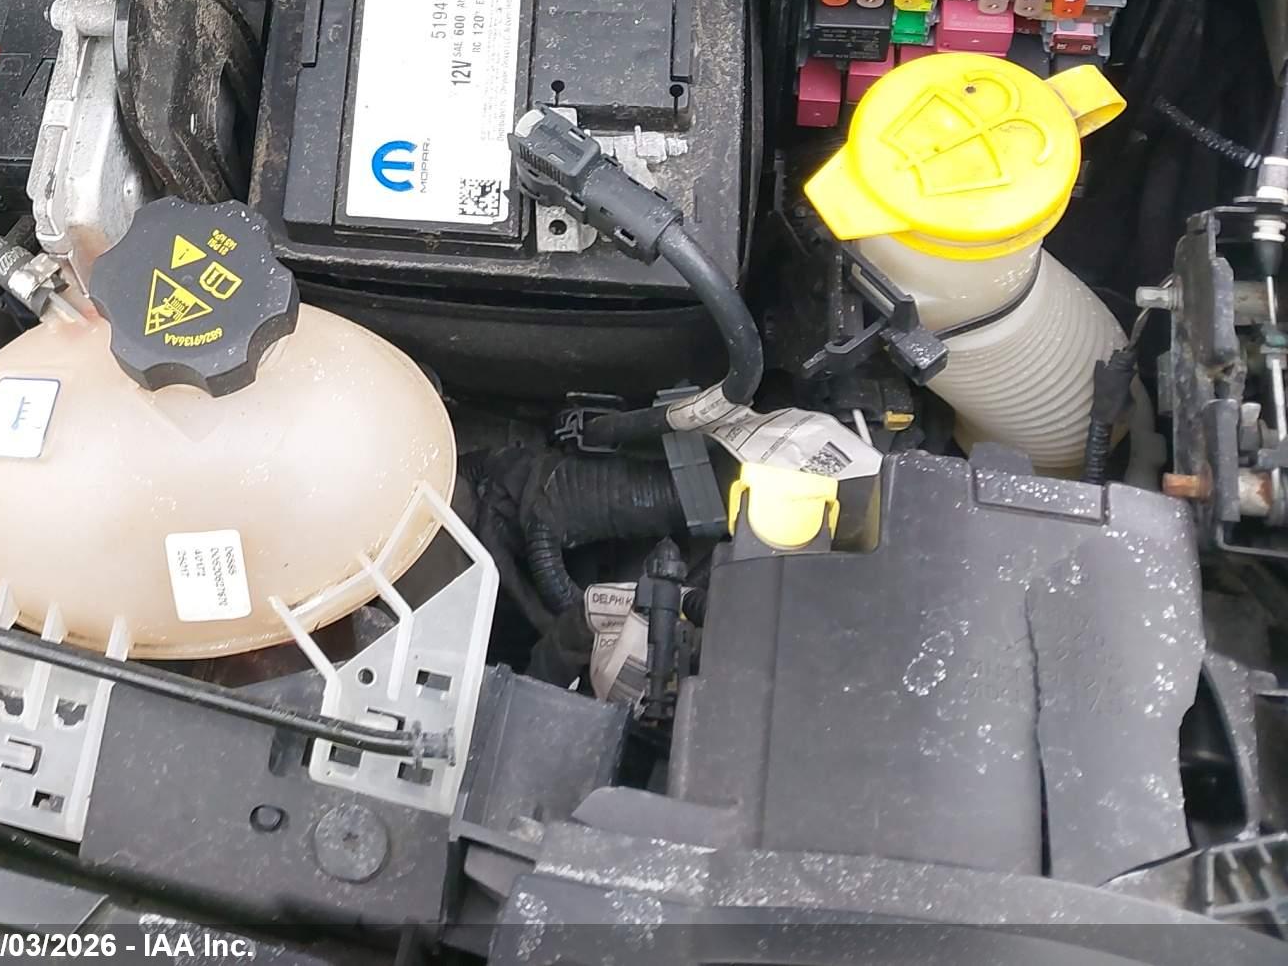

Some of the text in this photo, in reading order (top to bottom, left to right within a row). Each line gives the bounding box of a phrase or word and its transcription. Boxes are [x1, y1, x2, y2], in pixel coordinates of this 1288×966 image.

[454, 15, 466, 36] 600
[453, 42, 462, 58] SAE
[472, 42, 482, 53] RC
[451, 60, 472, 86] 12V
[420, 142, 430, 194] MOPAR
[592, 592, 624, 605] DELPHI
